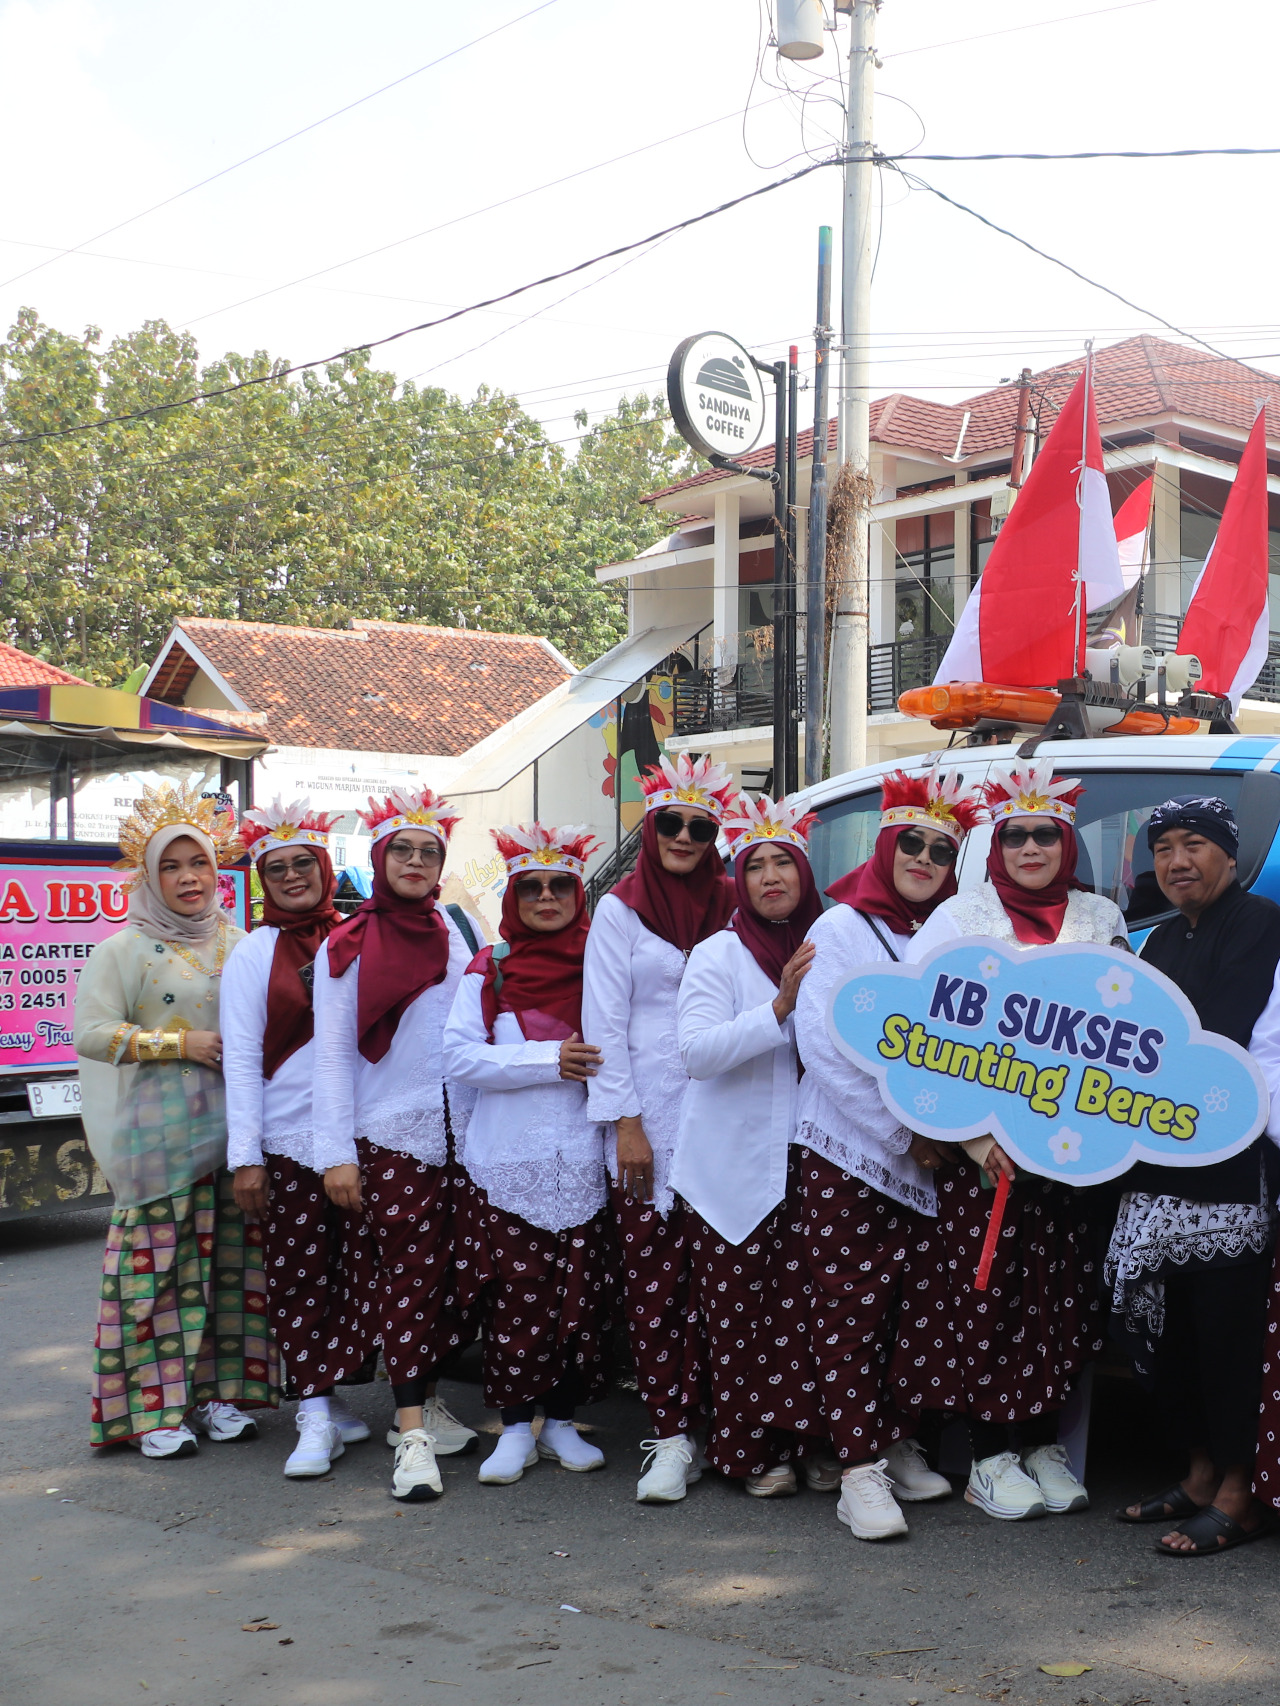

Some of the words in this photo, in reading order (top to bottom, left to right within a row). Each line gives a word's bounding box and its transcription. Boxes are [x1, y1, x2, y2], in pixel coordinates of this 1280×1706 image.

[699, 393, 751, 422] SANDHYA
[706, 415, 745, 439] COFFEE
[21, 969, 67, 985] 0005
[21, 993, 65, 1009] 2451
[928, 973, 989, 1027] KB
[998, 993, 1165, 1075] SUKSES
[877, 1013, 1070, 1118] Stunting
[1075, 1065, 1200, 1141] Beres
[33, 1086, 43, 1105] B
